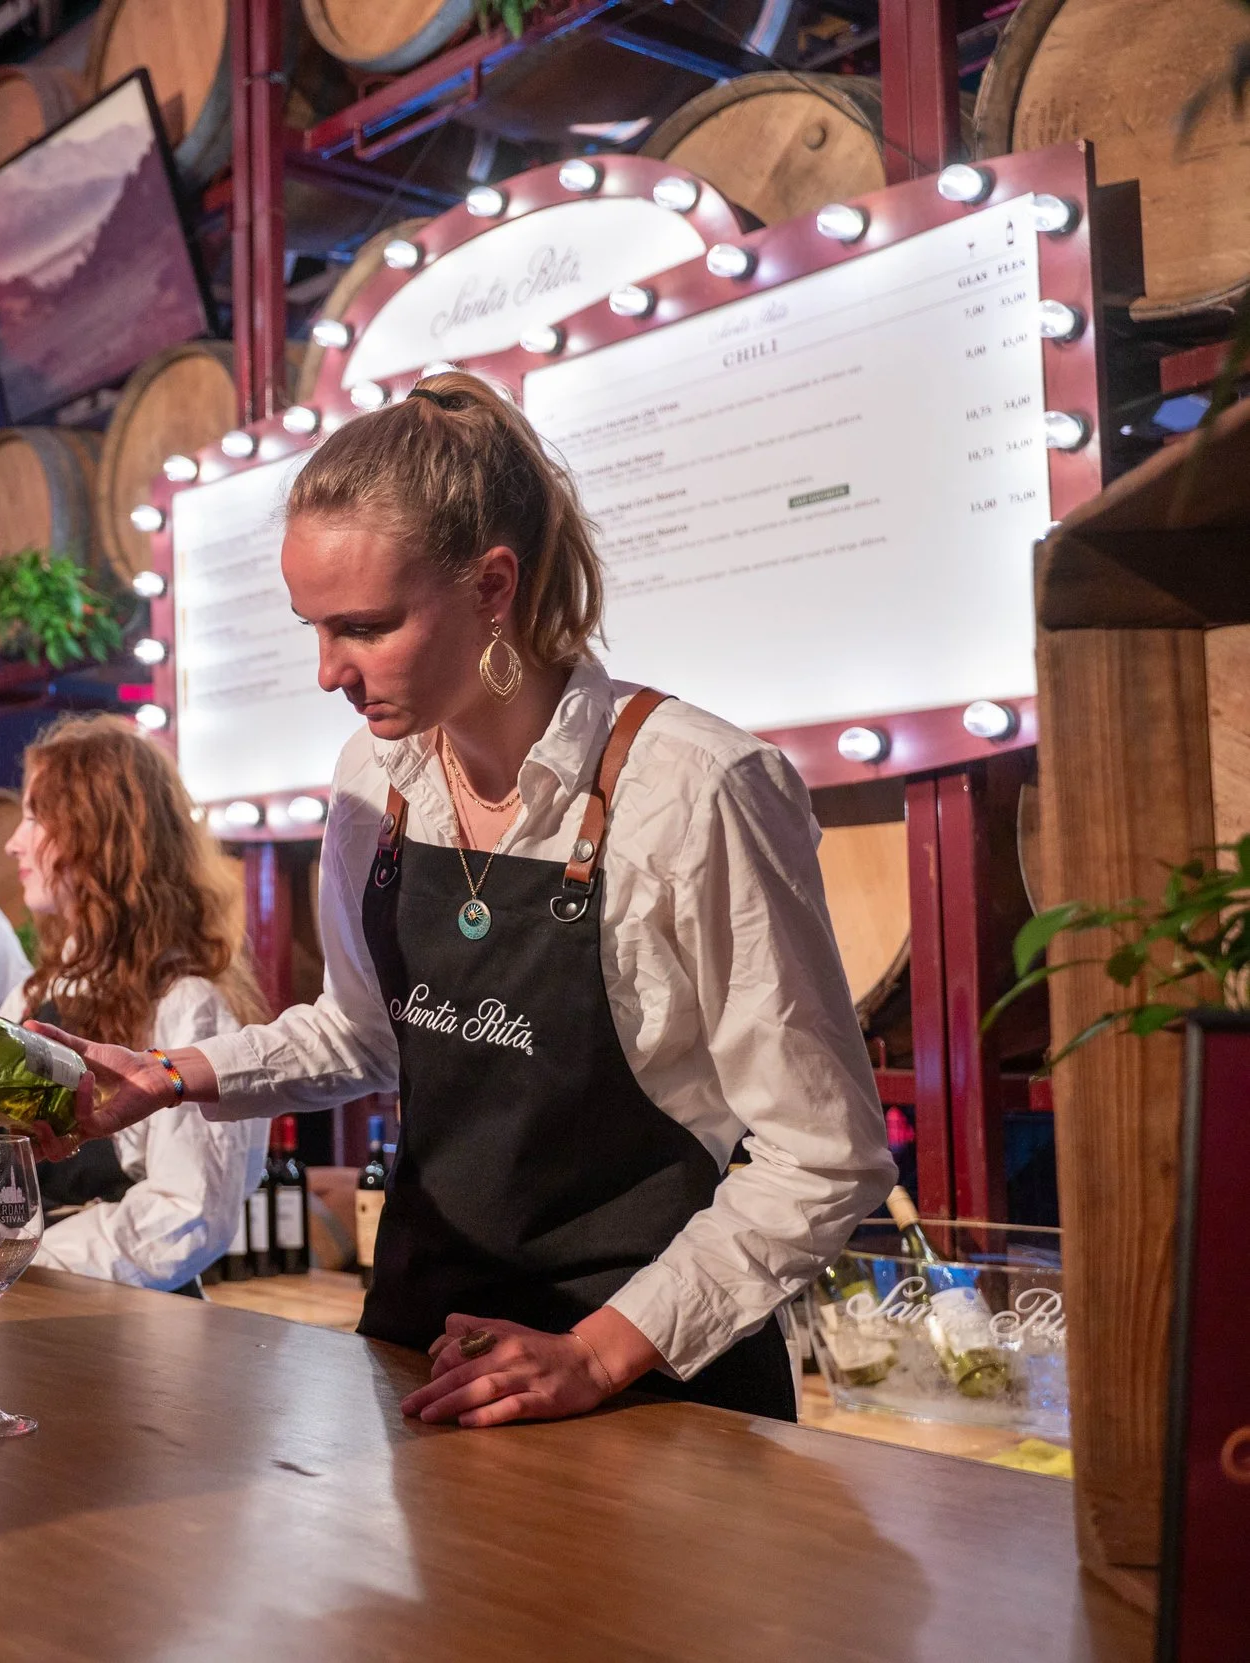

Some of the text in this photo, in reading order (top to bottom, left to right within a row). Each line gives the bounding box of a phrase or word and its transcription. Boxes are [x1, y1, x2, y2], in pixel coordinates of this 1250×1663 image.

[430, 243, 582, 340] Santa Rita
[722, 338, 778, 367] CHILI
[390, 983, 533, 1051] Santa Rita
[846, 1276, 934, 1325] San
[989, 1287, 1067, 1339] Ri
